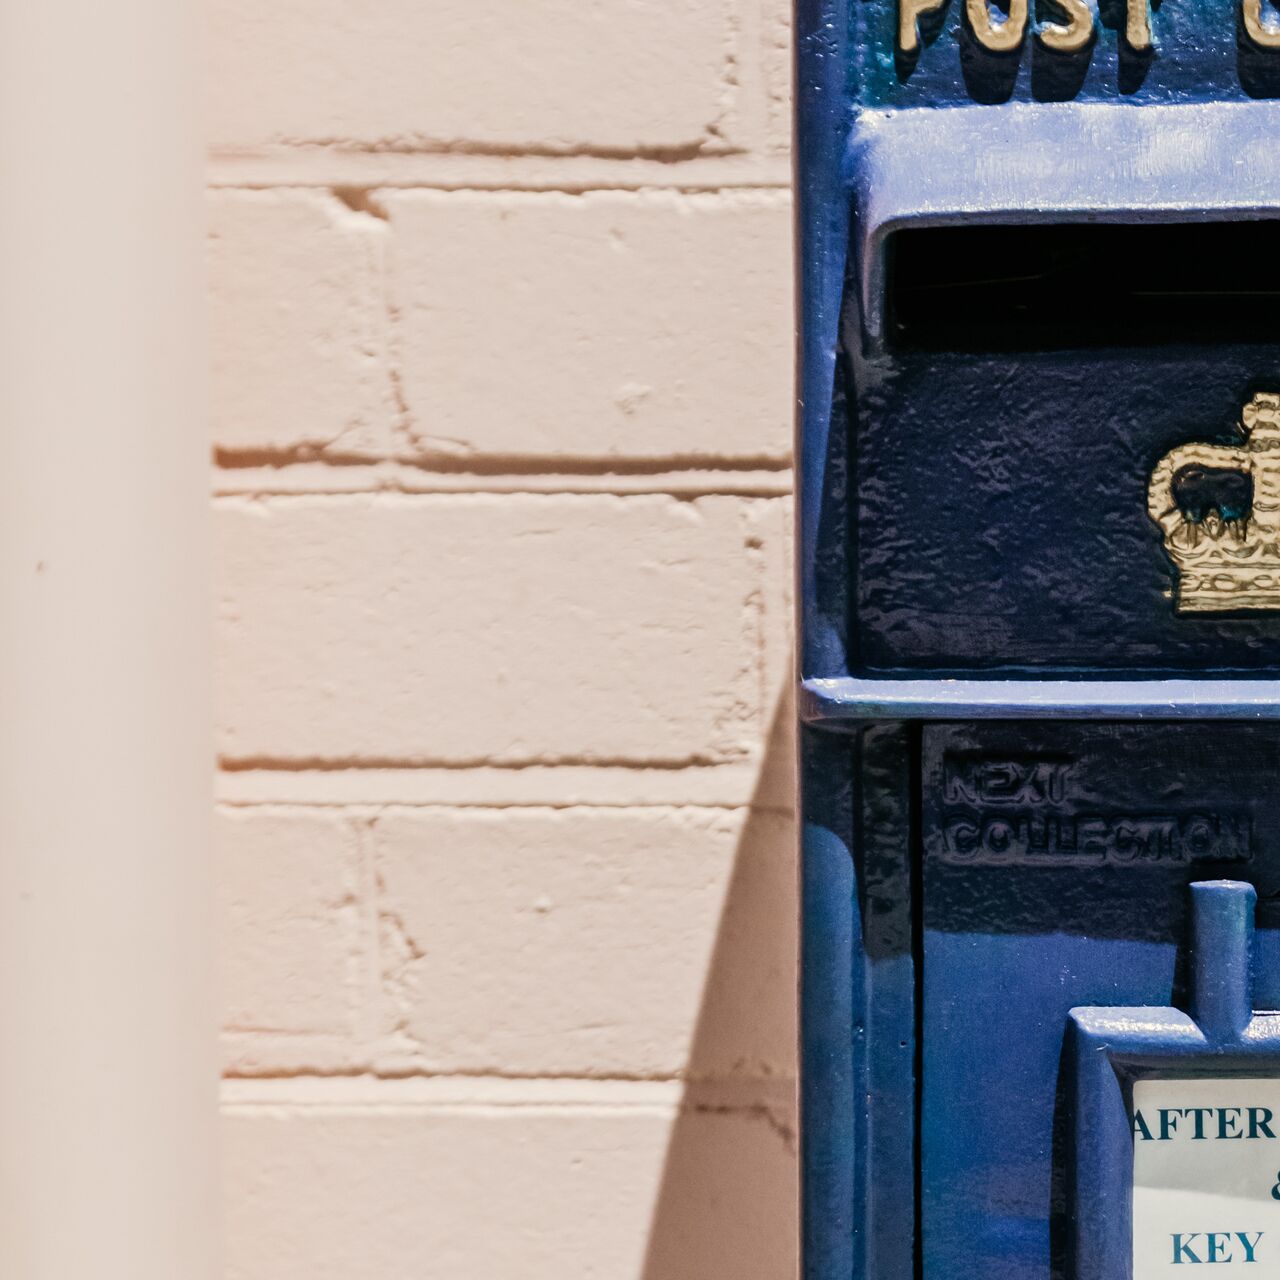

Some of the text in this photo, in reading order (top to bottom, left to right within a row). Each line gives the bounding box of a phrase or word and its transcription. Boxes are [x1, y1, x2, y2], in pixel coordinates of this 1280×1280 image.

[943, 754, 1070, 805] NEXT
[944, 813, 1253, 864] COLLECTION
[1133, 1107, 1276, 1141] AFTER
[1170, 1232, 1265, 1265] KEY
